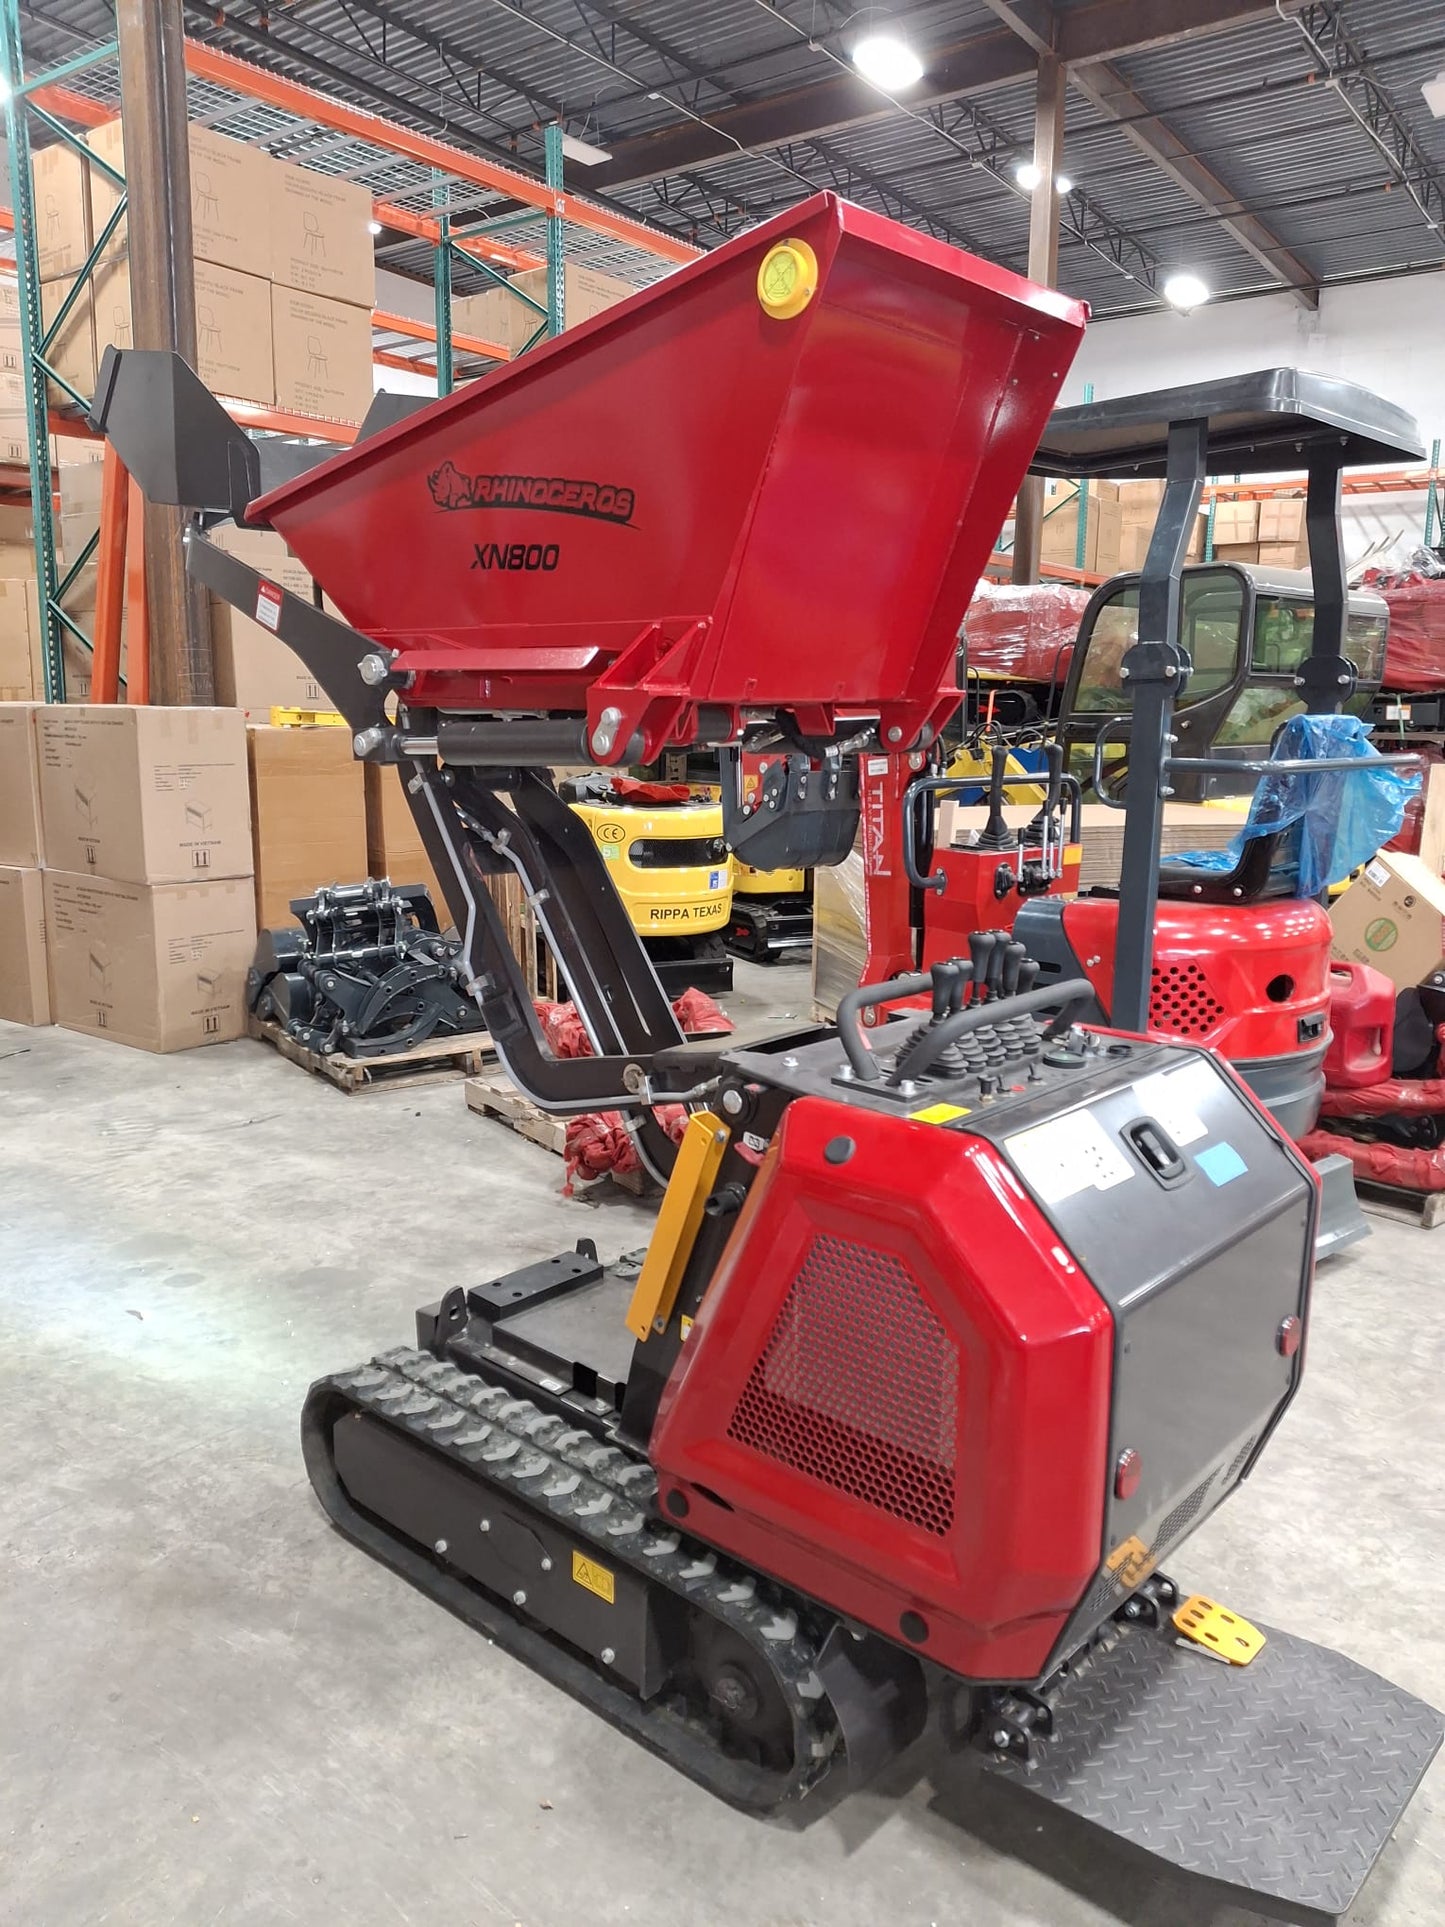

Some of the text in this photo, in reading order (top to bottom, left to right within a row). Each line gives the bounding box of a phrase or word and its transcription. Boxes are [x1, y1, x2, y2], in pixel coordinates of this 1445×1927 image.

[474, 475, 635, 519] RHINOCEROS
[470, 543, 560, 571] XN800
[872, 781, 891, 876] TITAN
[650, 903, 722, 920] RIPPA TEXAS
